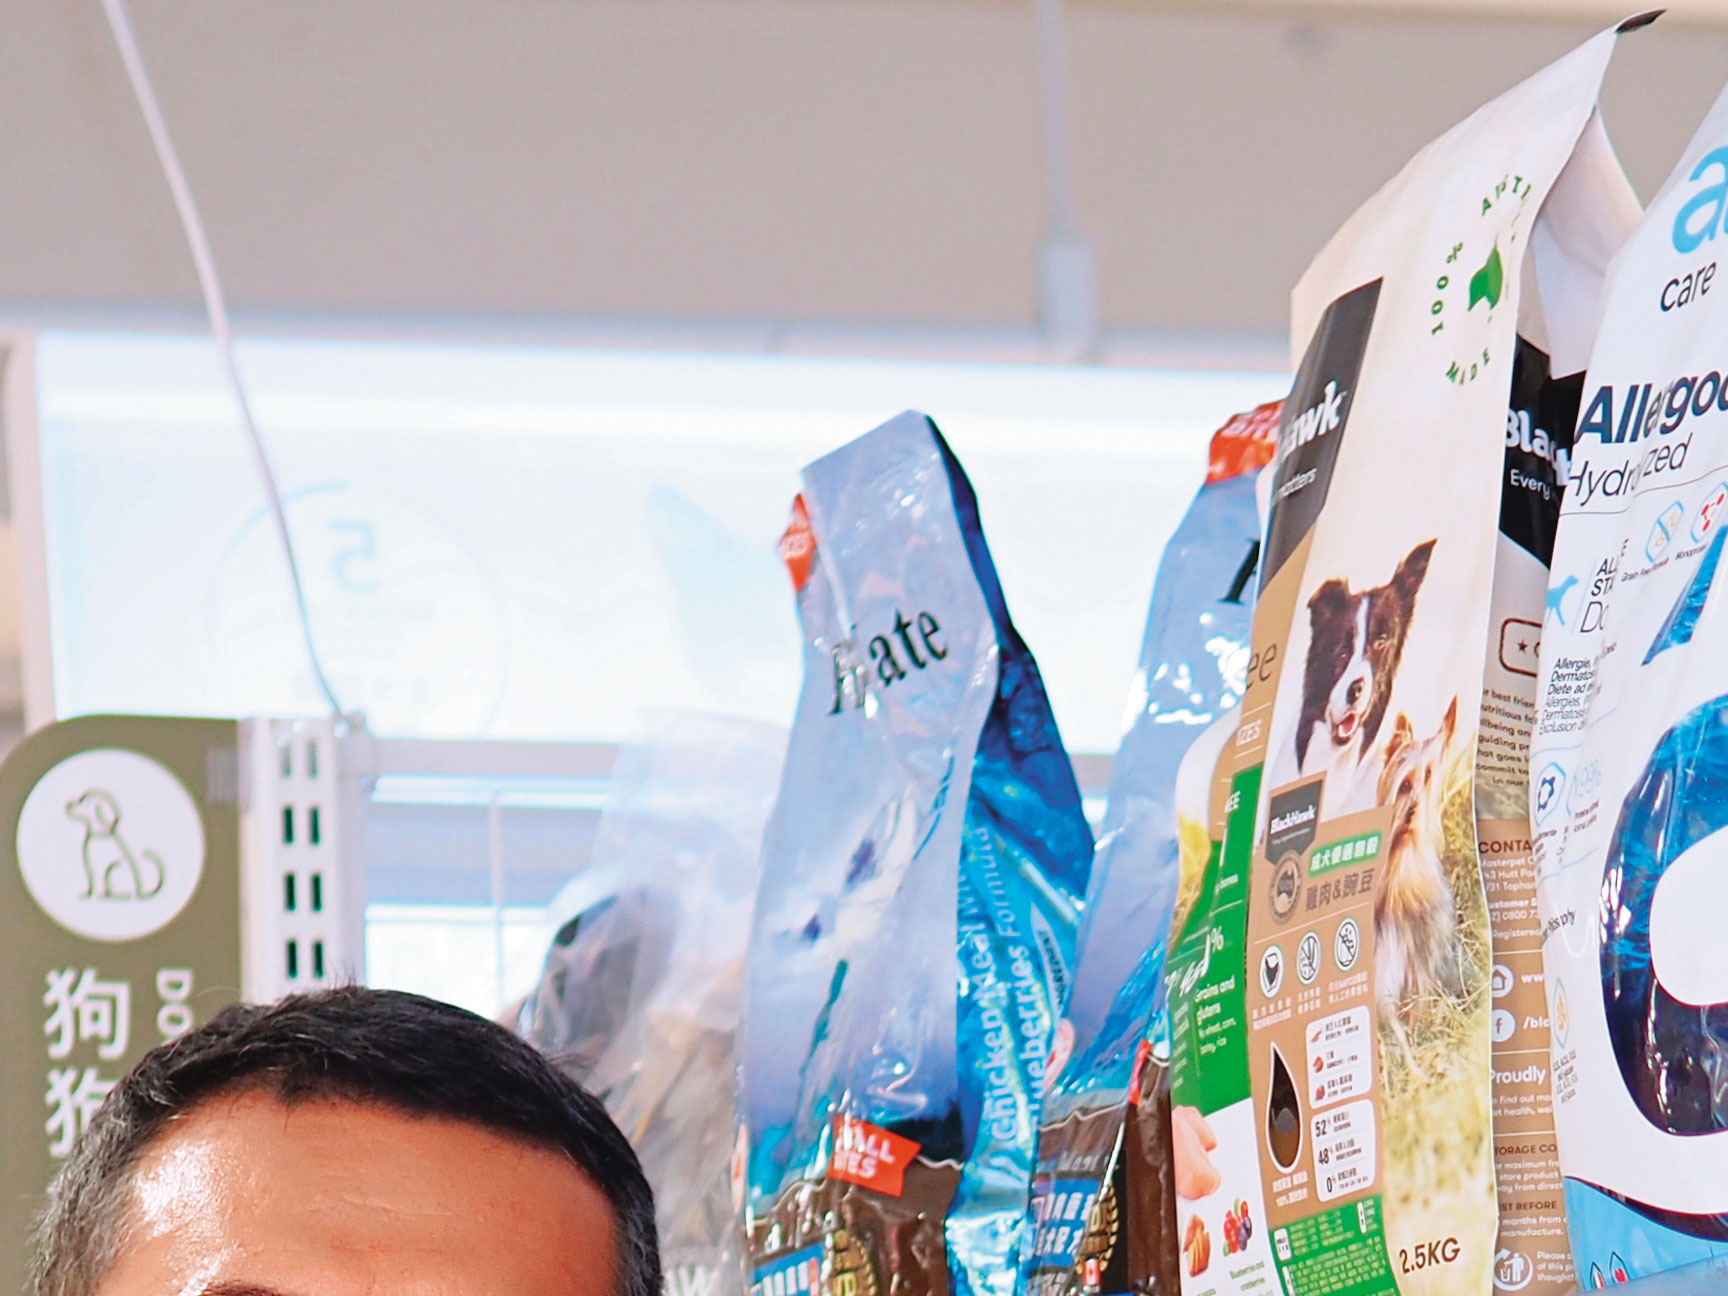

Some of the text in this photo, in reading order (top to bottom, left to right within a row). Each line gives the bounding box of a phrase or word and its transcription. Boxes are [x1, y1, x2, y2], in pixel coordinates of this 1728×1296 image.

[1659, 261, 1717, 313] care
[1509, 469, 1551, 502] Every
[1245, 641, 1278, 689] ee
[1480, 703, 1523, 722] utritious
[1480, 855, 1526, 869] asterpet
[1488, 898, 1530, 910] ustomer
[1494, 1143, 1537, 1156] TORAGE
[1515, 1200, 1558, 1211] BEFORE
[1398, 1236, 1462, 1275] 2.5KG
